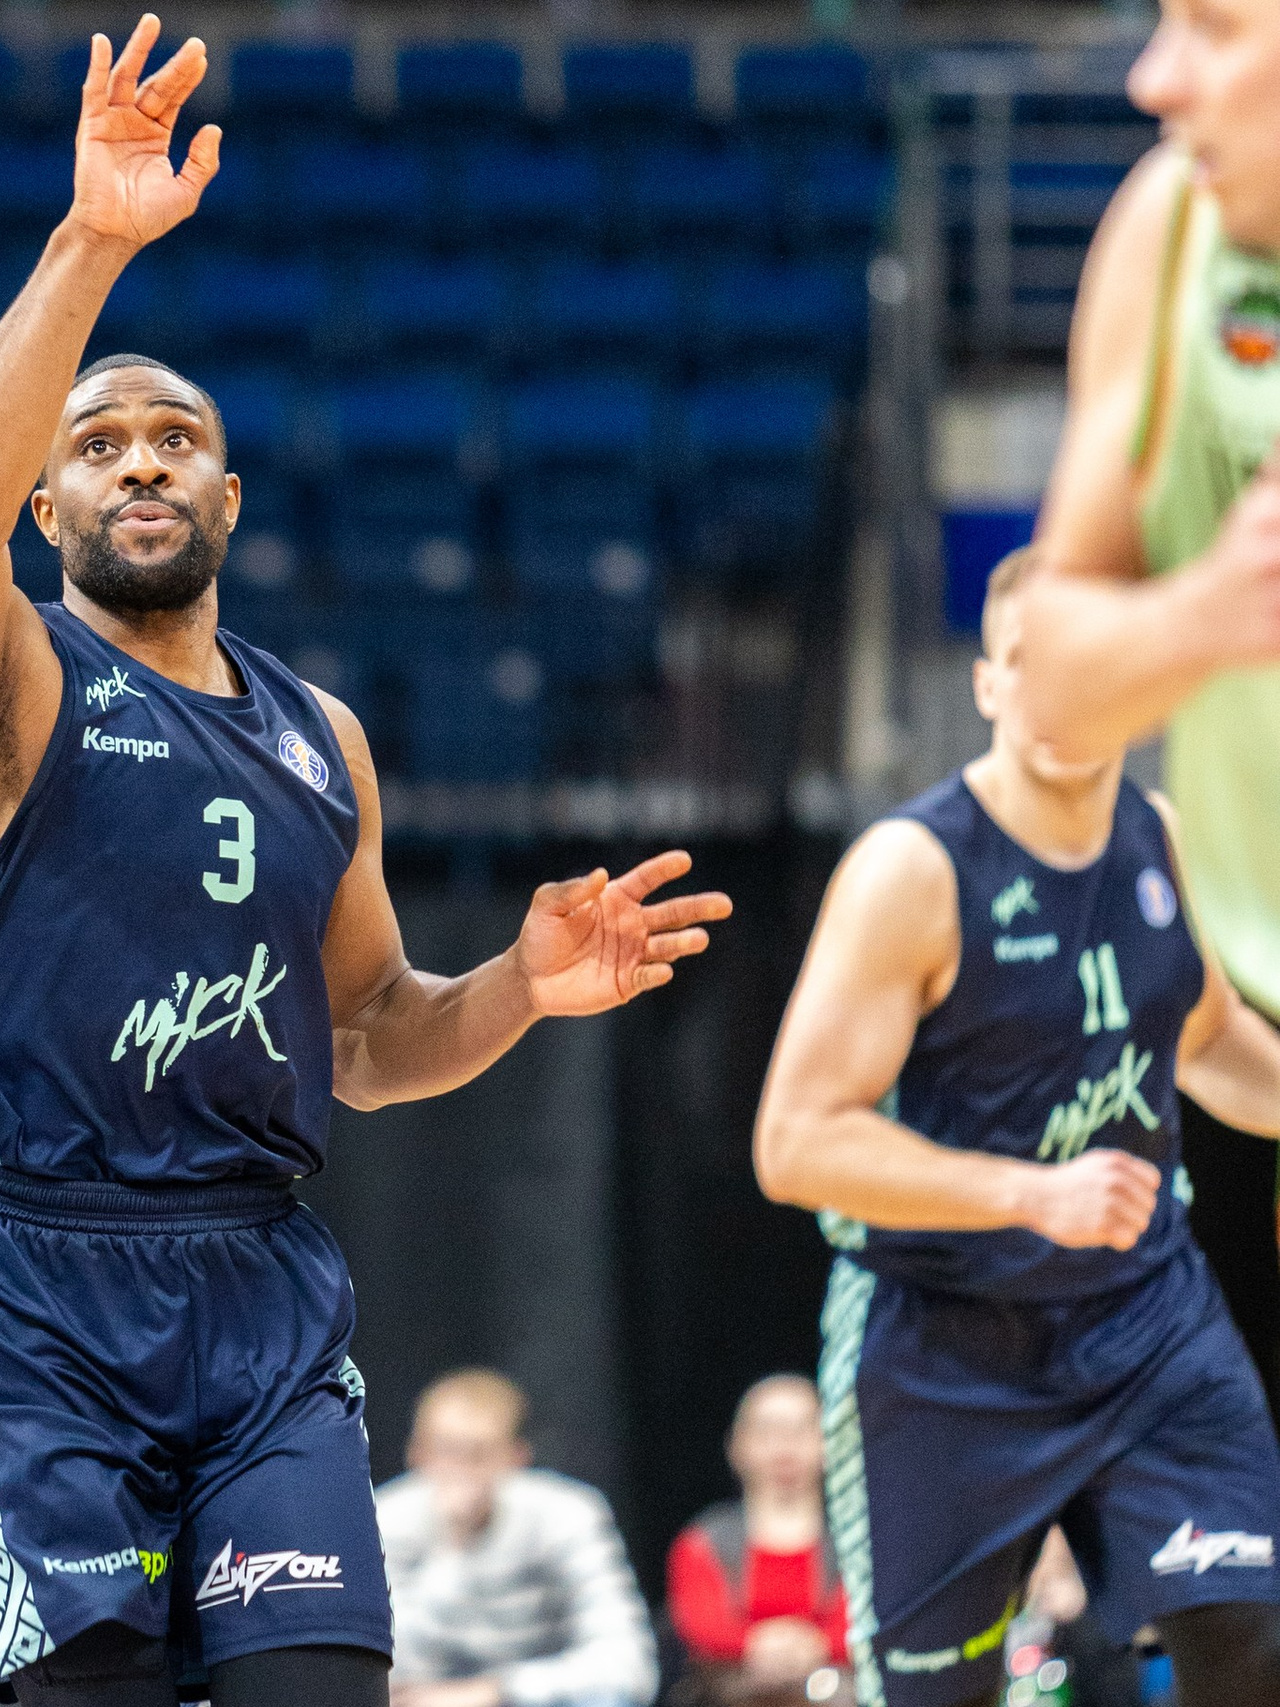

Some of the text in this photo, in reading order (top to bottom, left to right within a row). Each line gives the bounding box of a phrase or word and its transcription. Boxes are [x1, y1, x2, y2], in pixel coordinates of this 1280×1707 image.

[82, 726, 170, 763] Kempa
[202, 797, 256, 904] 3
[1078, 942, 1130, 1035] 11
